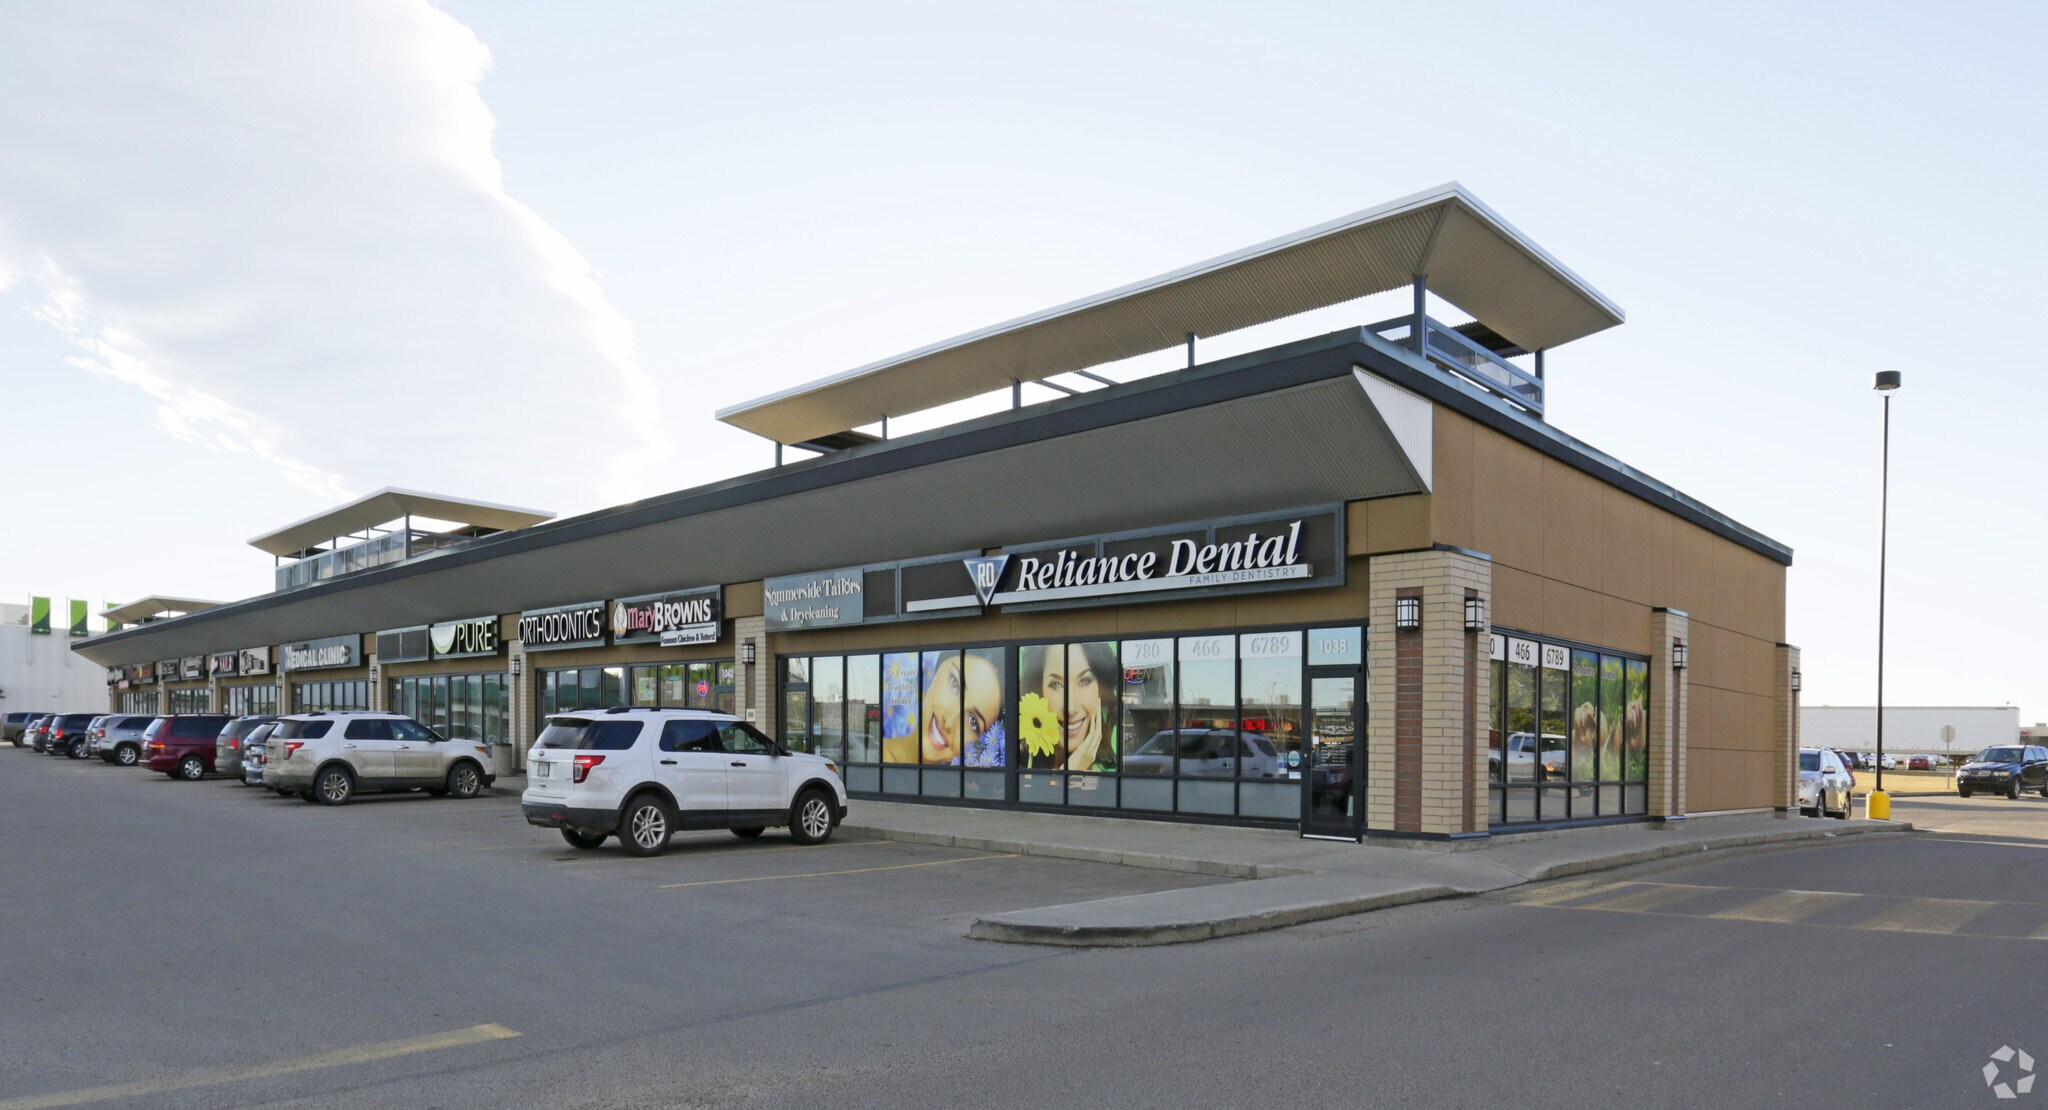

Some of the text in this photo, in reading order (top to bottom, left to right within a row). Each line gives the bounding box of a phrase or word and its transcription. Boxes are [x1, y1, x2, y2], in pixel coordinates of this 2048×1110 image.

[1016, 520, 1302, 592] Reliance Dental
[977, 562, 995, 588] RD
[1189, 567, 1297, 585] FAMILY DENTISTRY
[781, 604, 840, 624] & Drycleaning
[457, 620, 493, 652] PURE
[518, 608, 600, 645] ORTHODONTICS
[284, 645, 318, 669] MEDICAL
[318, 645, 349, 666] CLINIC
[1134, 636, 1290, 660] 780 466 6789
[1319, 639, 1349, 654] 1038
[1515, 642, 1531, 661] 466
[1546, 648, 1564, 666] 6789
[721, 668, 734, 678] 1042
[1123, 667, 1152, 681] OPEN
